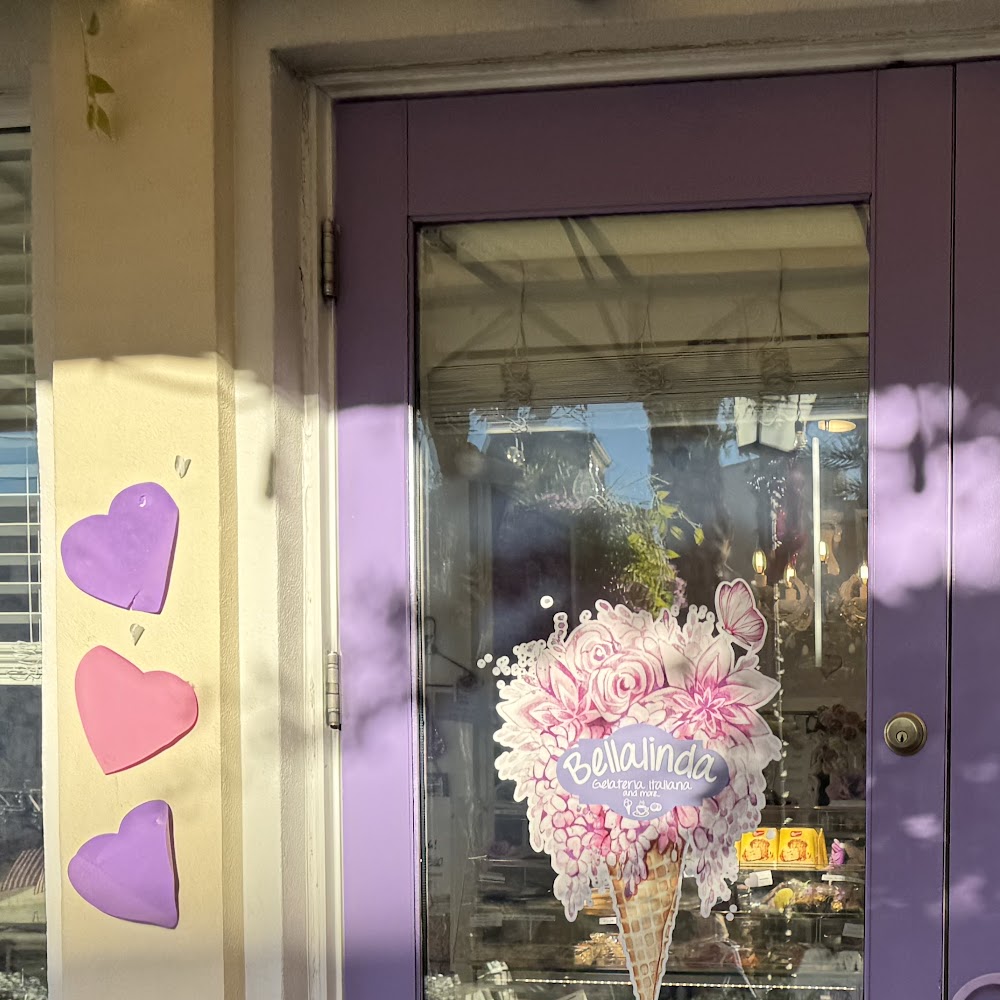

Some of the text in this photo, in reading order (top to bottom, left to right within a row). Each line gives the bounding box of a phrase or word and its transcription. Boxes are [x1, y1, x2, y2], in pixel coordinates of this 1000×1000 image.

[562, 736, 718, 785] Bellalinda
[592, 778, 645, 790] Gelateria
[622, 789, 638, 797] and
